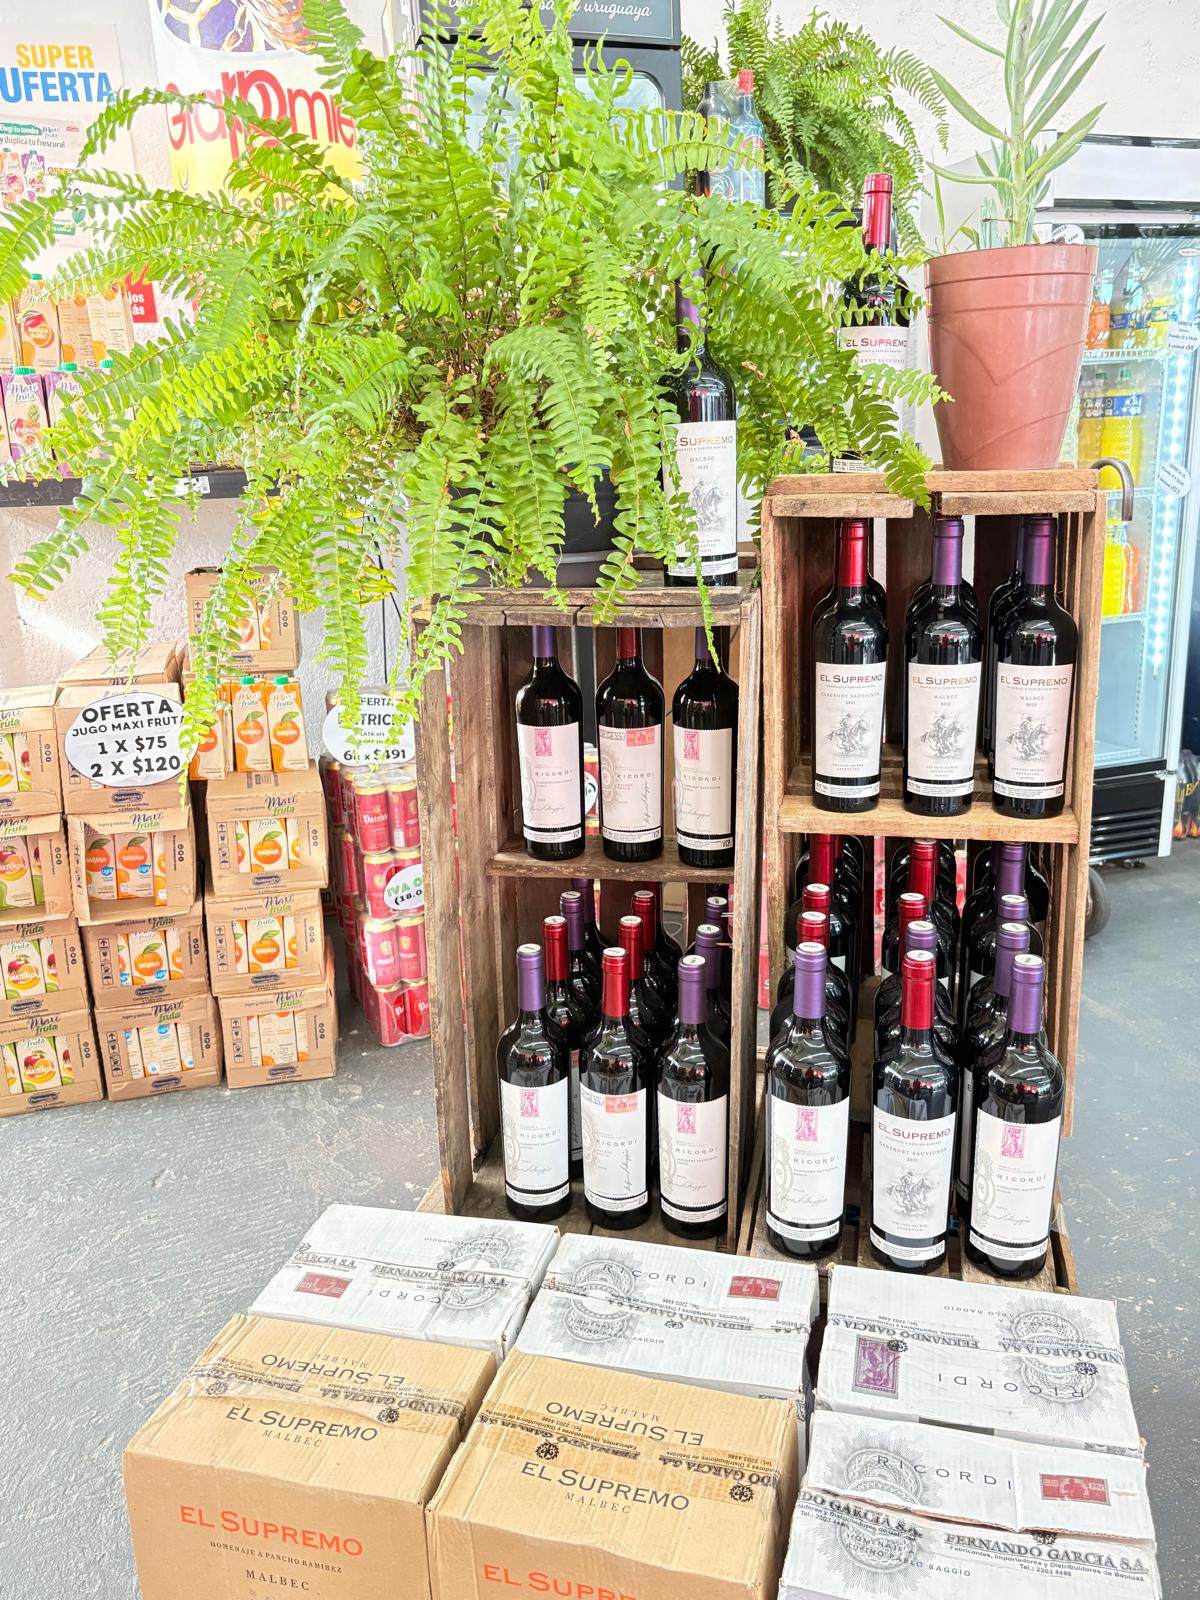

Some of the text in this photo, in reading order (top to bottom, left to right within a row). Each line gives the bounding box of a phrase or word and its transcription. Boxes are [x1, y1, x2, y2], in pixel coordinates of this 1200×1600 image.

[584, 2, 652, 21] uruguaya
[16, 43, 95, 69] SUPER
[680, 435, 734, 447] SUPREMO
[820, 674, 883, 684] EL SUPREMO
[912, 676, 978, 686] EL SUPREMO
[1000, 675, 1068, 687] EL SUPREMO
[82, 699, 173, 723] OFERTA
[72, 724, 107, 737] JUGO
[112, 720, 144, 732] MAXI
[97, 735, 167, 754] 1 X $75
[90, 756, 181, 778] 2 X $120
[265, 795, 298, 810] Maxi
[272, 805, 295, 817] fruta
[130, 812, 164, 826] Maxi
[136, 821, 161, 832] fruta
[4, 825, 28, 836] fruta
[386, 882, 411, 897] IVA
[264, 895, 295, 910] Maxi
[268, 904, 291, 917] fruta
[274, 991, 305, 1004] Maxi
[279, 1000, 301, 1010] fruta
[152, 1001, 184, 1016] Maxi
[28, 1016, 62, 1030] Maxi
[158, 1011, 182, 1024] fruta
[35, 1024, 58, 1036] fruta
[26, 1037, 46, 1048] fruta
[878, 1122, 951, 1141] EL SUPREMO
[676, 1147, 718, 1155] RICORDI
[793, 1155, 840, 1165] RICORDI
[997, 1174, 1047, 1183] RICORDI
[371, 1264, 440, 1281] FERNANDO
[602, 1264, 708, 1288] RICORDI
[368, 1288, 468, 1305] RICORDI
[842, 1319, 897, 1337] GARCIA
[899, 1330, 981, 1349] FERNANDO
[1025, 1345, 1082, 1358] GARCIA
[315, 1353, 369, 1368] MALBEC
[261, 1353, 373, 1385] SUPREMO
[378, 1374, 406, 1387] EL
[938, 1373, 1085, 1398] RICORDI
[601, 1403, 661, 1422] MALBEC
[226, 1406, 378, 1441] EL SUPREMO
[546, 1401, 705, 1446] EL SUPREMO
[262, 1429, 322, 1448] MALBEC
[742, 1456, 758, 1464] 2203
[686, 1461, 745, 1481] GARCIA
[876, 1453, 1014, 1490] RICORDI
[521, 1461, 690, 1511] EL SUPREMO
[565, 1491, 631, 1514] MALBEC
[800, 1509, 814, 1518] Tel.:
[180, 1505, 363, 1557] EL SUPREMO
[944, 1532, 1044, 1557] FERNANDO
[210, 1541, 257, 1557] HOMENAJE
[265, 1552, 300, 1566] PANCHO
[301, 1560, 343, 1574] RAMIREZ
[949, 1545, 994, 1559] Fabricantes,
[994, 1553, 1043, 1567] Importadores
[483, 1564, 522, 1588] EL
[928, 1563, 971, 1577] BAGGIO
[1019, 1563, 1035, 1572] Tel.:
[1036, 1565, 1054, 1575] 2203
[245, 1568, 311, 1592] MALBEC
